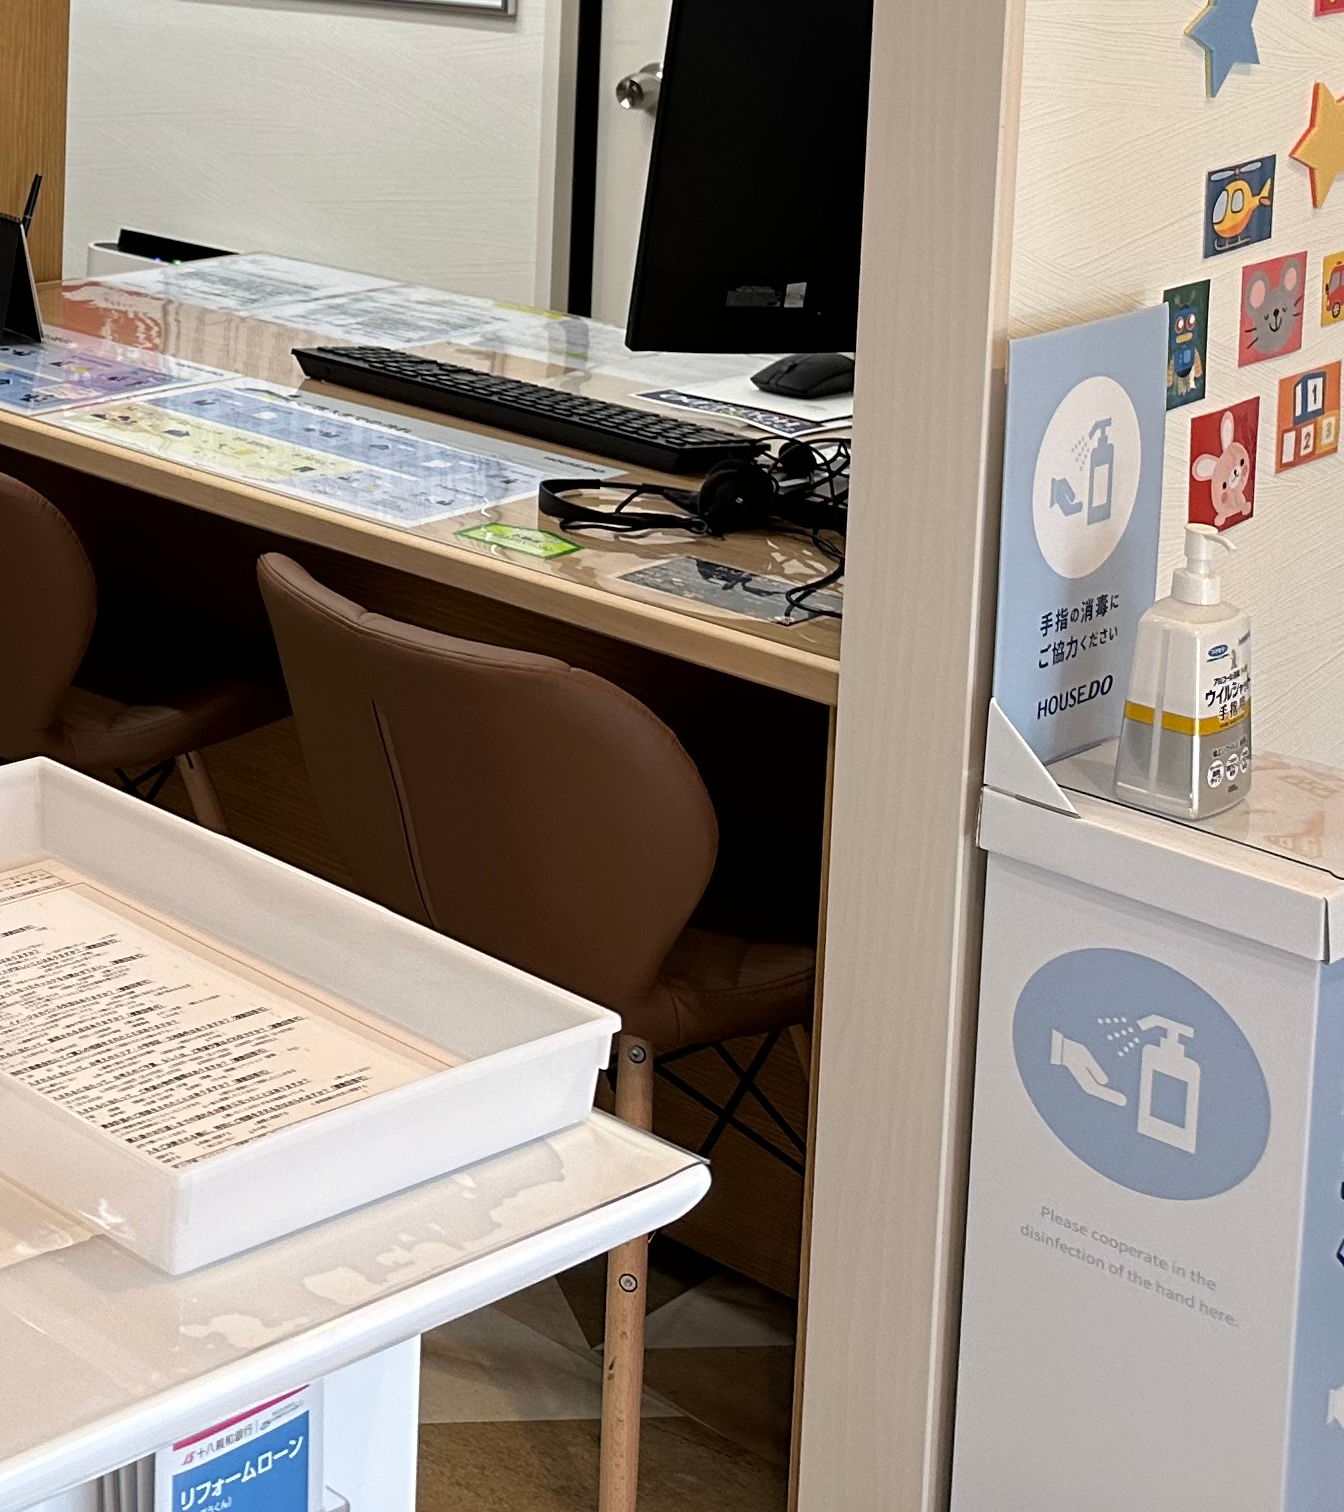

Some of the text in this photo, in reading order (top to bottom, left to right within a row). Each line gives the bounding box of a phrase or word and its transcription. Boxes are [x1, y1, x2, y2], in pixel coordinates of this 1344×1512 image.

[1311, 383, 1318, 405] 1
[1303, 430, 1311, 450] 2
[1040, 594, 1119, 637] 手指の消毒に
[1039, 626, 1118, 668] ご協力ください
[1037, 674, 1113, 720] HOUSEDO
[1041, 1205, 1217, 1291] Please cooperate in the
[1020, 1224, 1239, 1328] disinfection of the hand here.
[181, 1436, 304, 1511] リフォームローン
